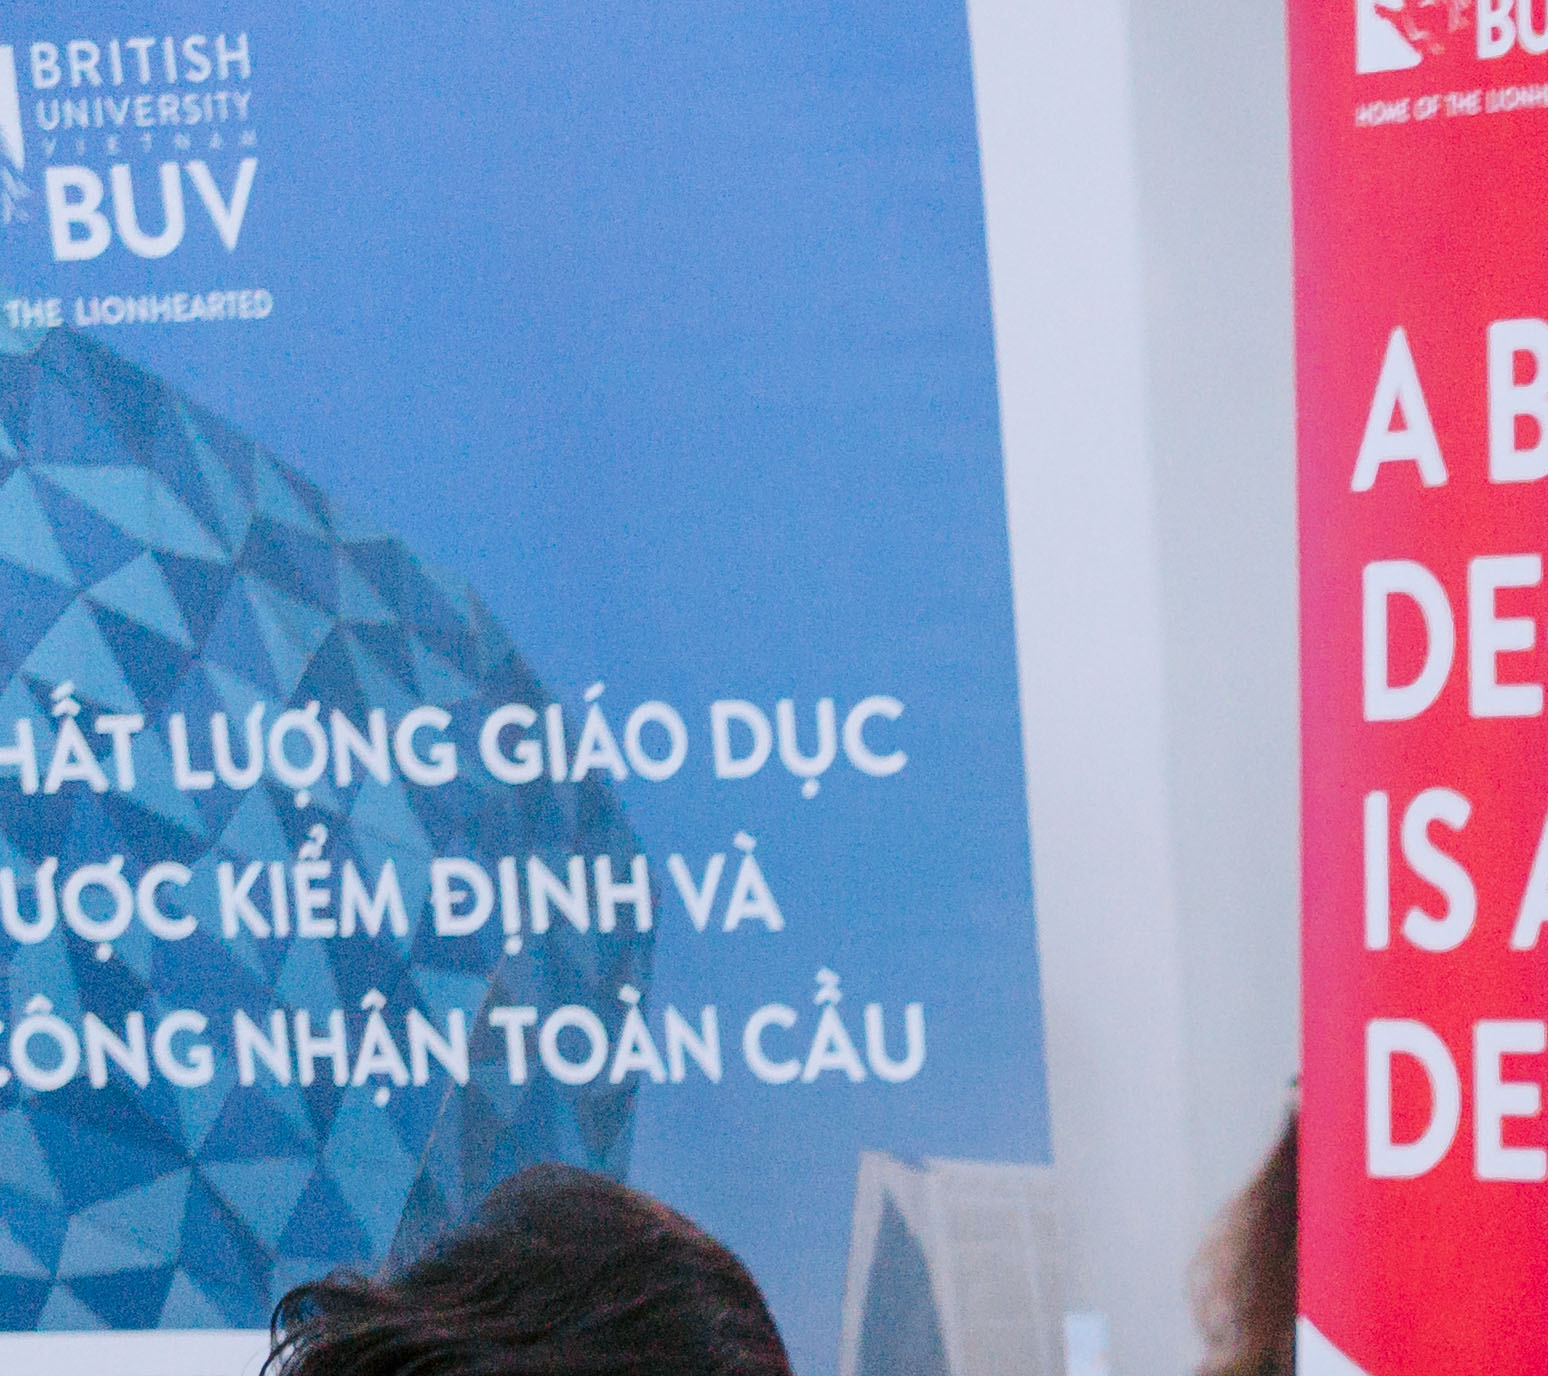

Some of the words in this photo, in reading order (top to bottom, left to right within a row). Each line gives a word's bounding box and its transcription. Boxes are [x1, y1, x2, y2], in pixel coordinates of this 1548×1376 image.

[29, 32, 250, 89] BRITISH
[36, 91, 250, 131] UNIVERSITY
[44, 157, 258, 262] BUV
[4, 297, 63, 328] THE
[74, 288, 274, 327] LIONHEARTED
[1351, 325, 1448, 492] A
[0, 680, 144, 796] HẤT
[171, 698, 458, 809] LƯỢNG
[480, 681, 688, 786] GIÁO
[711, 695, 909, 798] DỤC
[0, 852, 199, 961] ƯỢC
[217, 824, 409, 940] KIỂM
[431, 854, 654, 955] ĐỊNH
[666, 831, 785, 933] VÀ
[1364, 787, 1477, 952] IS
[234, 989, 471, 1107] NHẬN
[489, 985, 724, 1085] TOÀN
[742, 968, 927, 1085] CẦU
